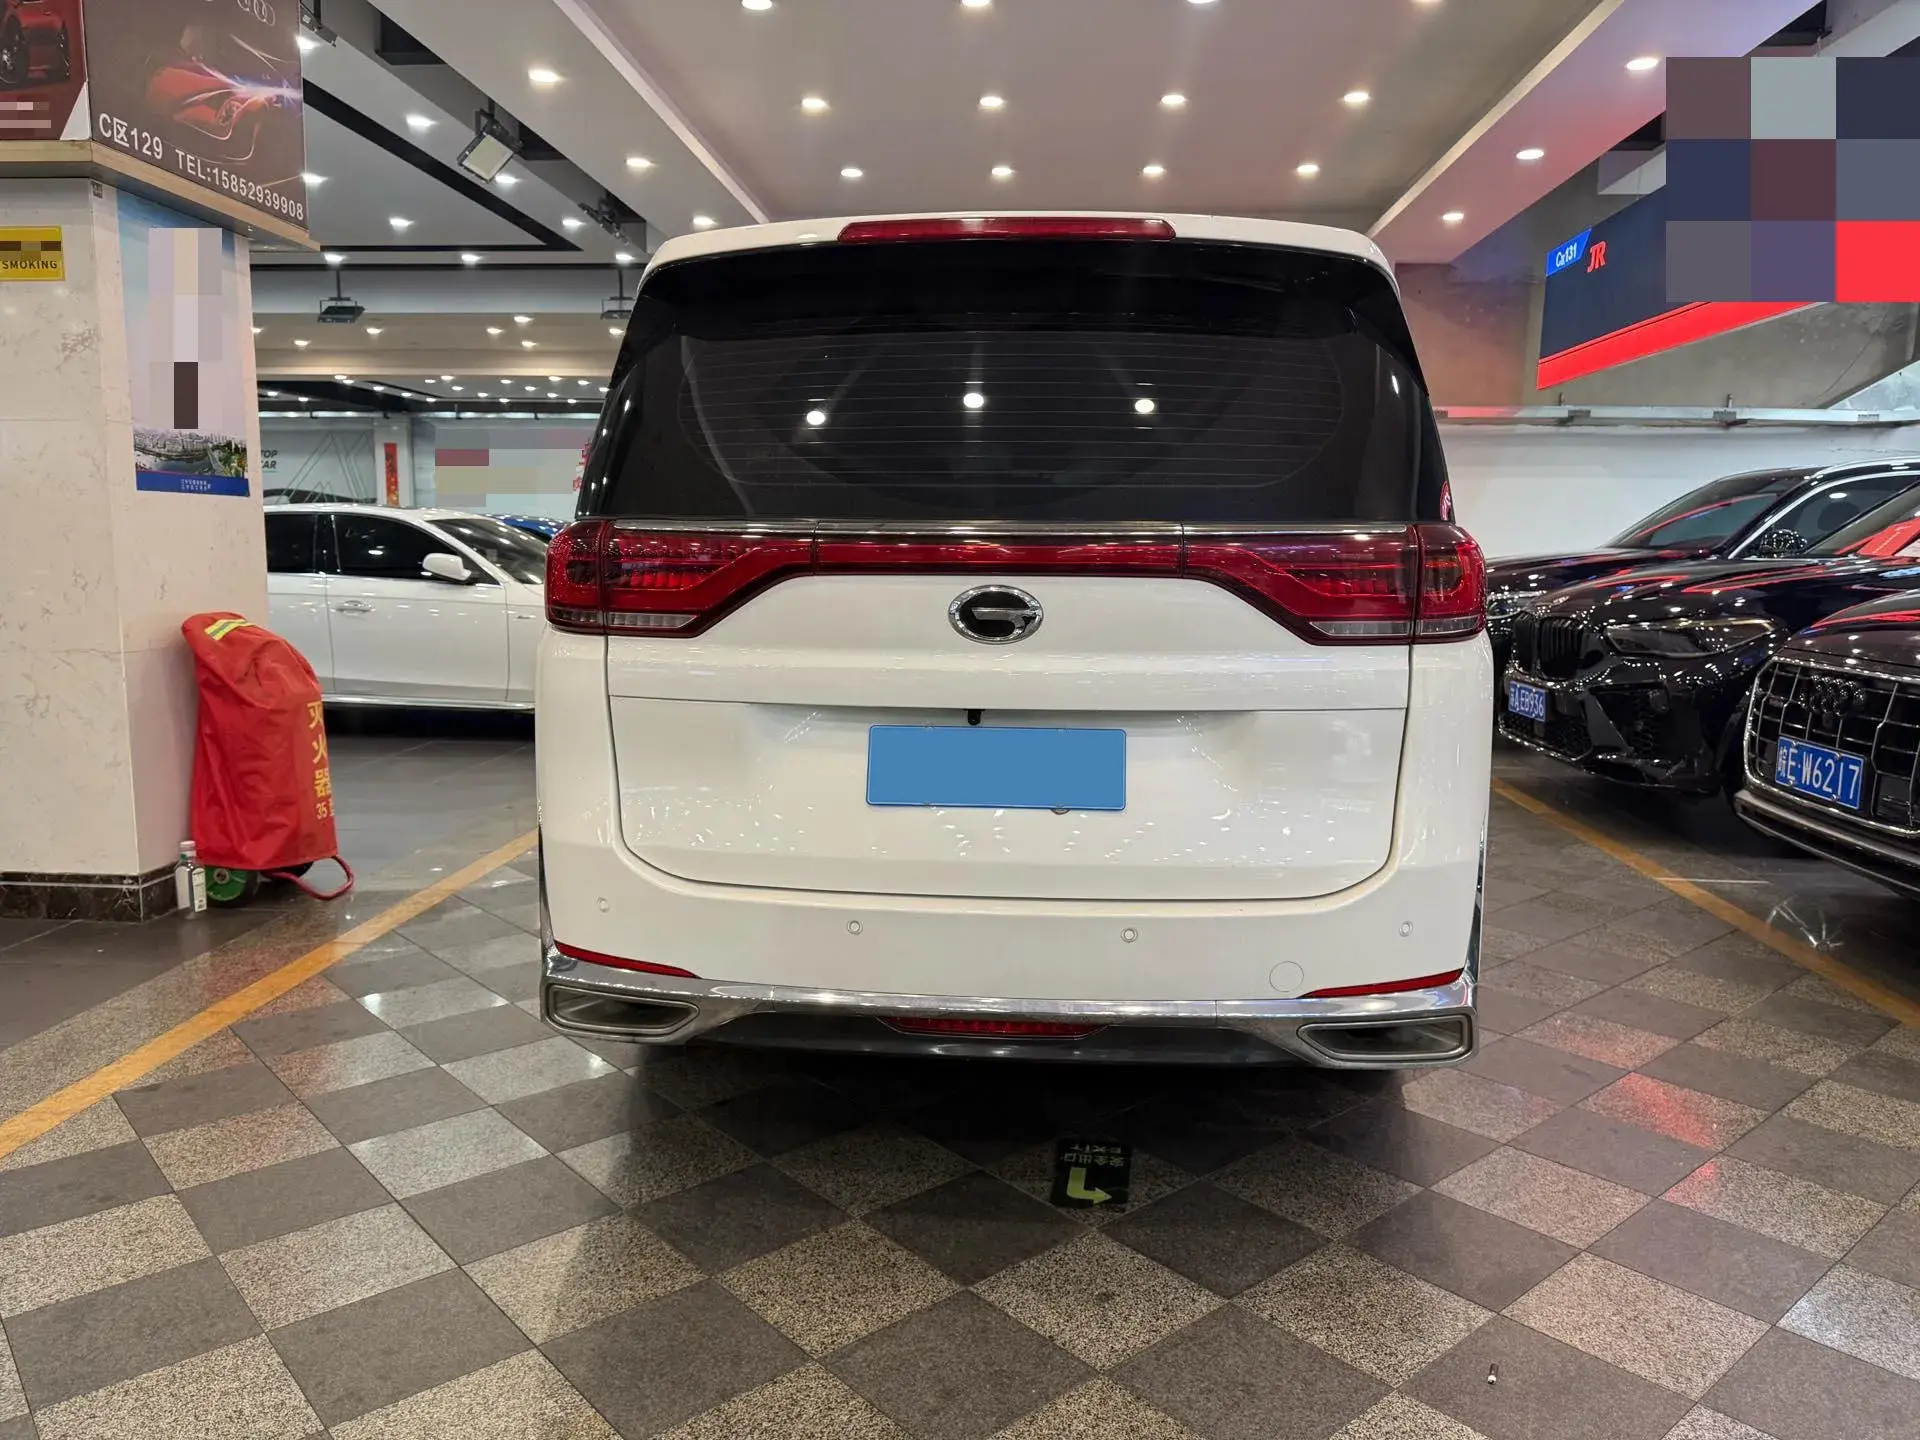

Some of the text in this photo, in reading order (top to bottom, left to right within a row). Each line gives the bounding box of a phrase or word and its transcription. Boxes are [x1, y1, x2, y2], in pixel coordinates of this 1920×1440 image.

[99, 113, 304, 221] C区129 TEL:15852939908
[2, 260, 58, 270] SMOKING
[261, 460, 277, 469] AR
